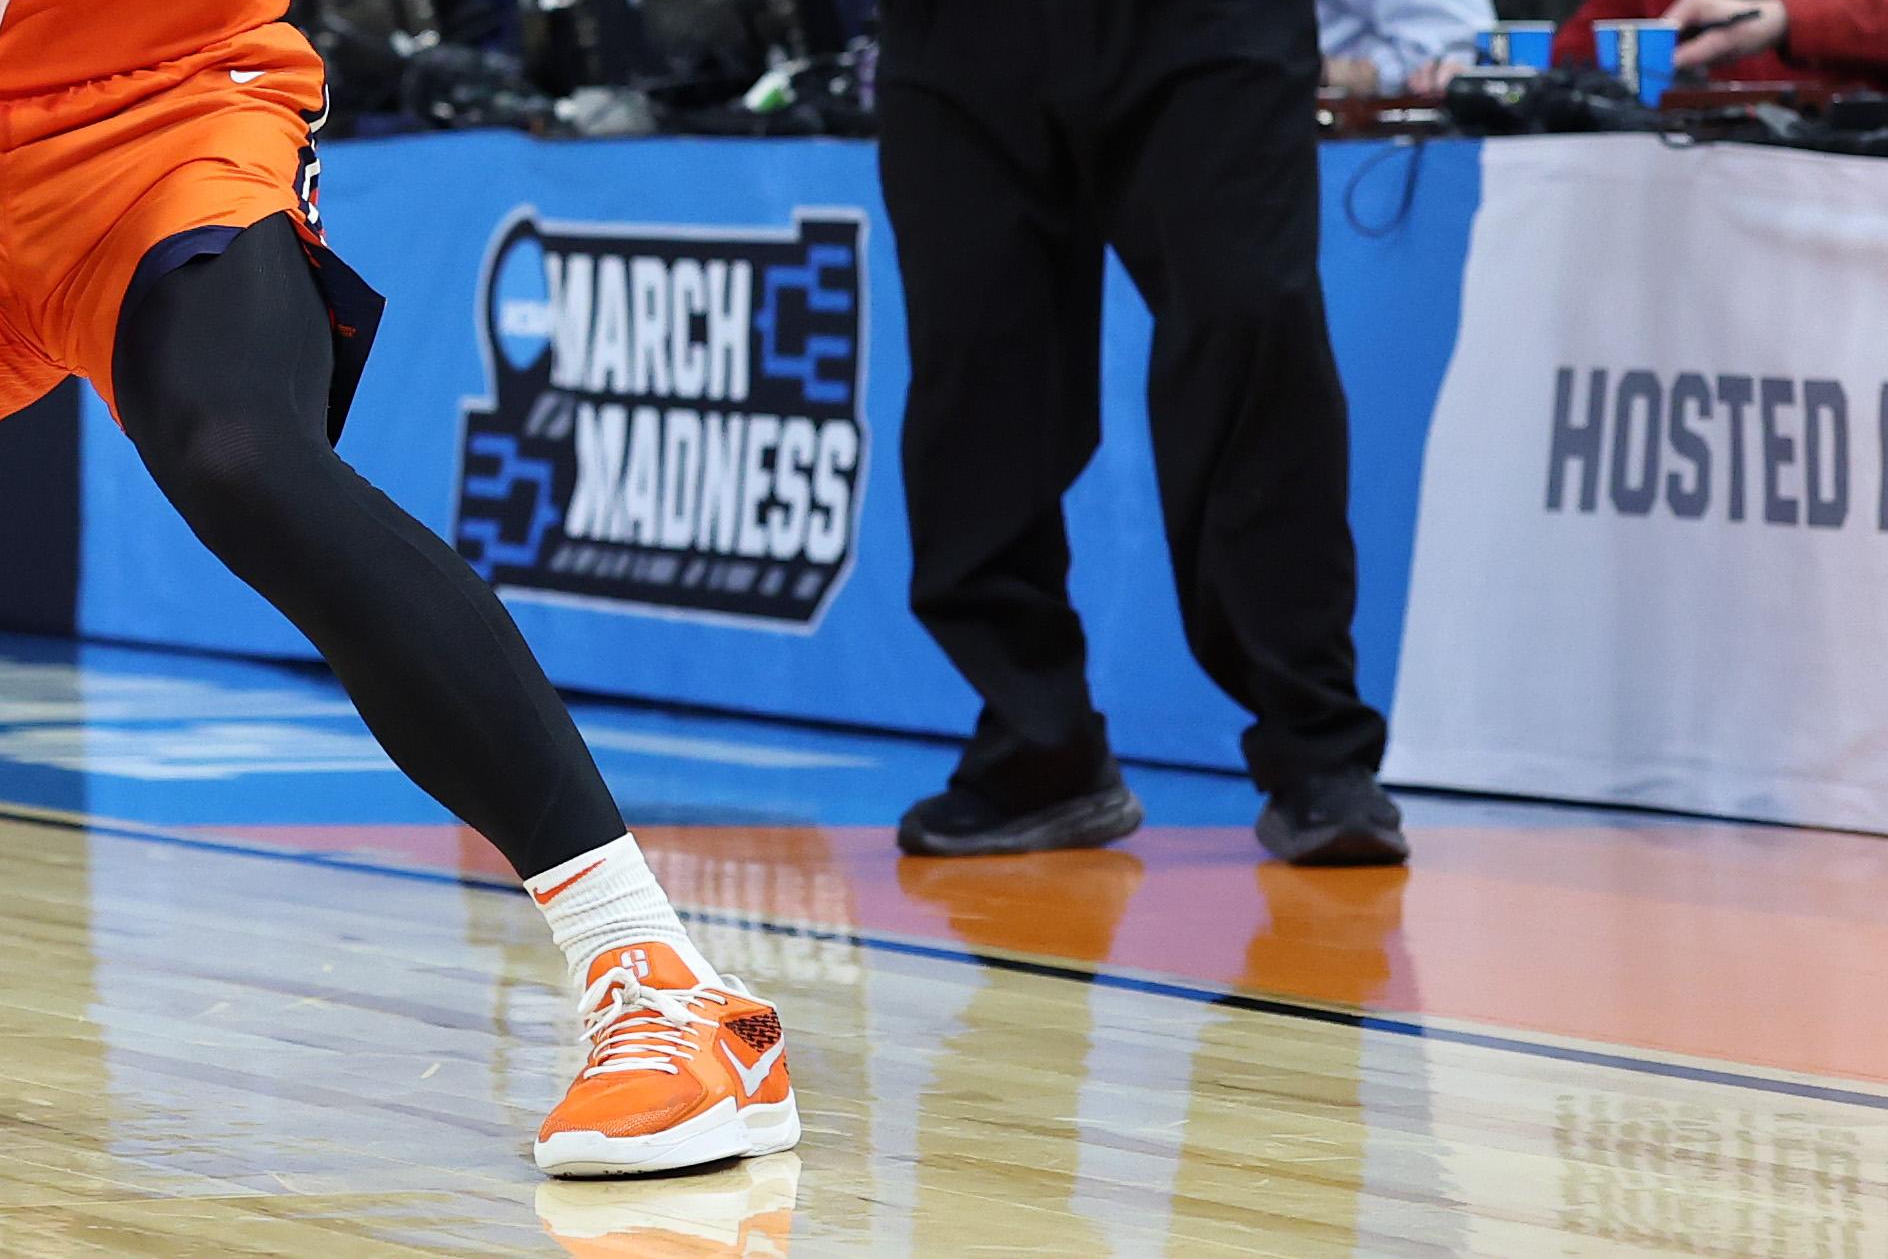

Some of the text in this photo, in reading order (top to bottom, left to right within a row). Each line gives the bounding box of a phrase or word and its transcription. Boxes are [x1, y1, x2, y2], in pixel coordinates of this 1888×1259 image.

[546, 251, 753, 402] MARCH
[563, 401, 859, 565] MADNESS
[1544, 366, 1850, 530] HOSTED
